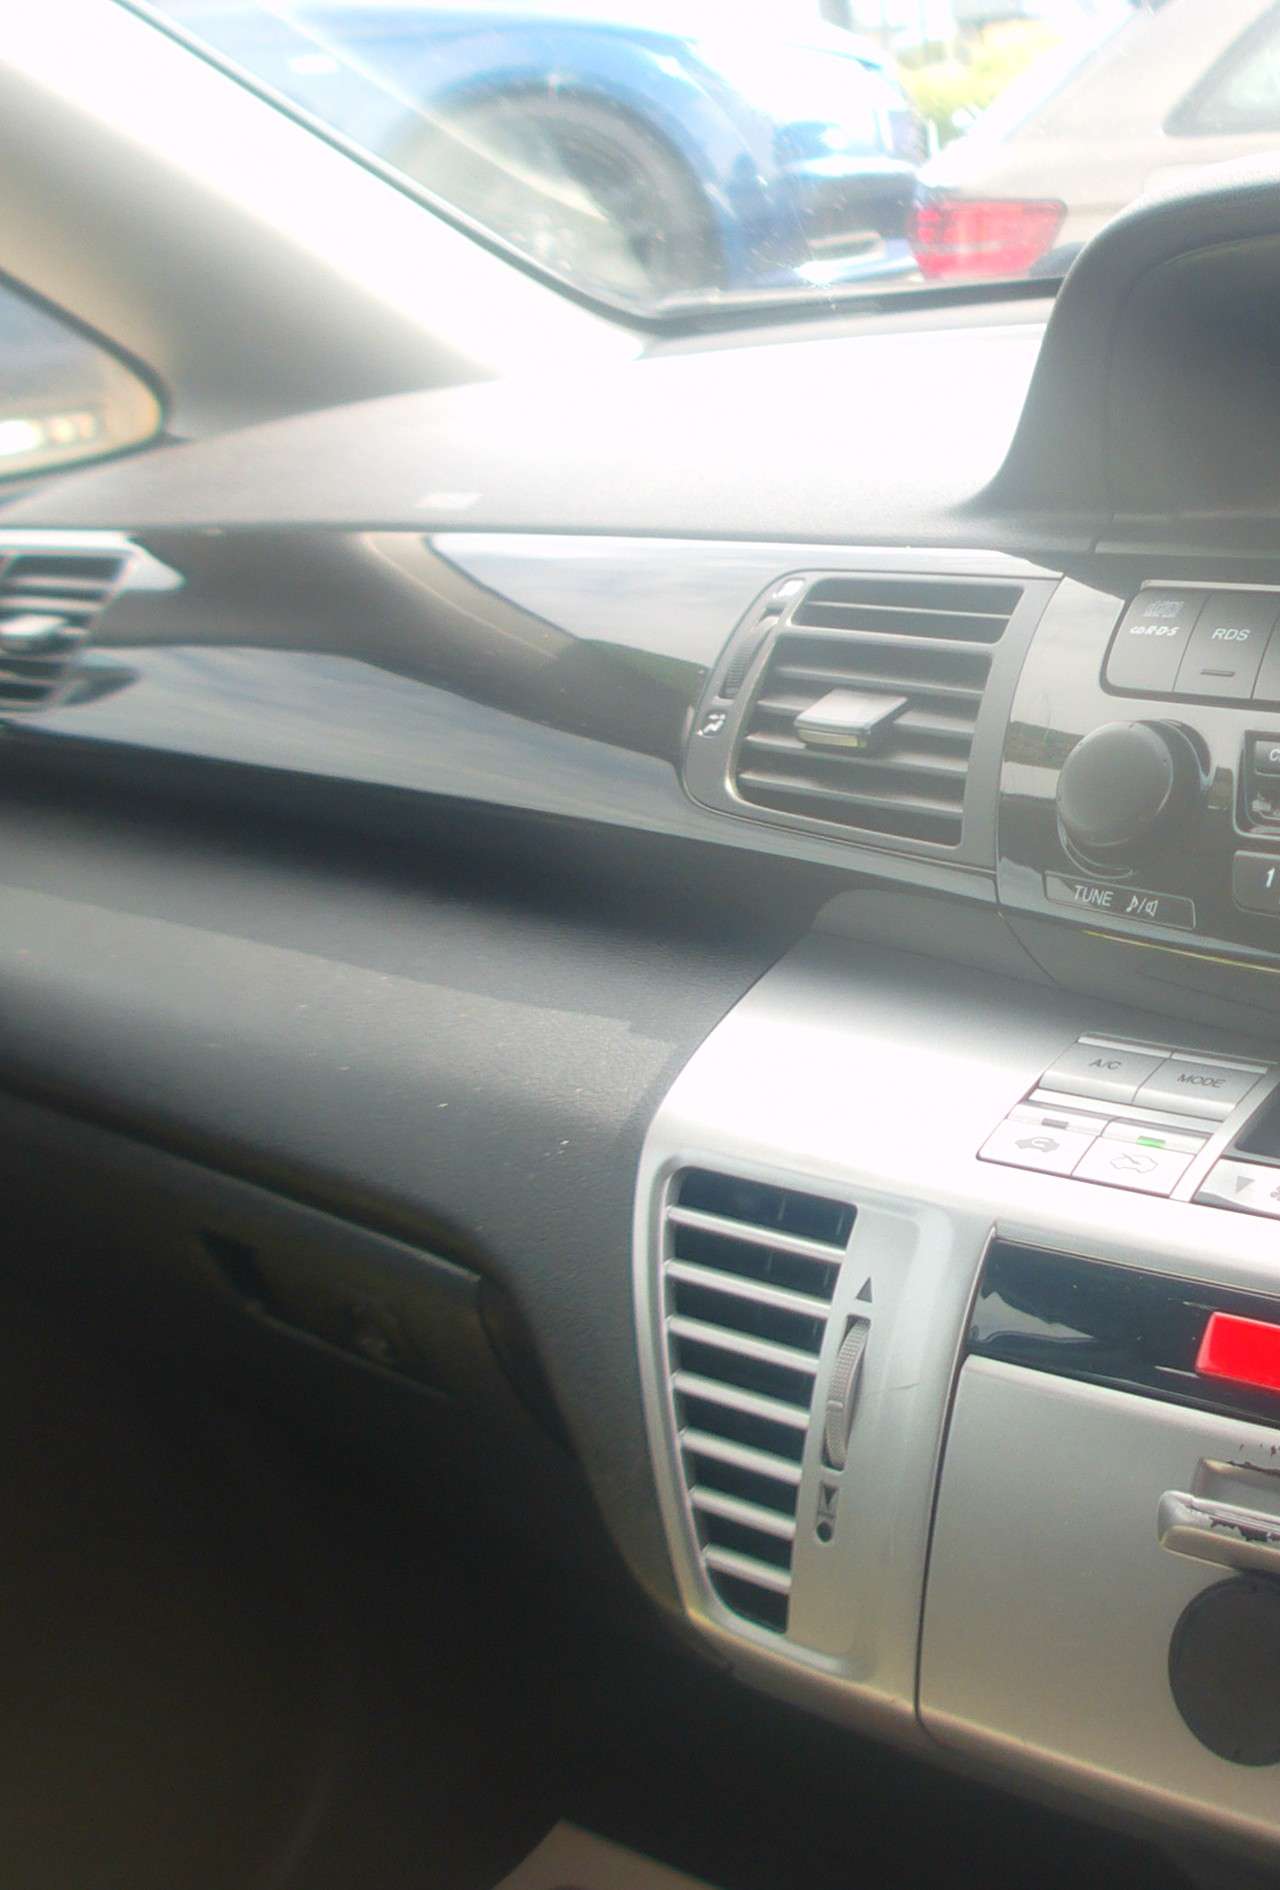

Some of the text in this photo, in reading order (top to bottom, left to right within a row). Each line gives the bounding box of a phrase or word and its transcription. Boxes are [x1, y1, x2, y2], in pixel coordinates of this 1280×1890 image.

[1211, 627, 1252, 643] RDS
[1265, 867, 1277, 889] 1
[1073, 885, 1114, 908] TUNE
[1175, 1073, 1226, 1089] MODE
